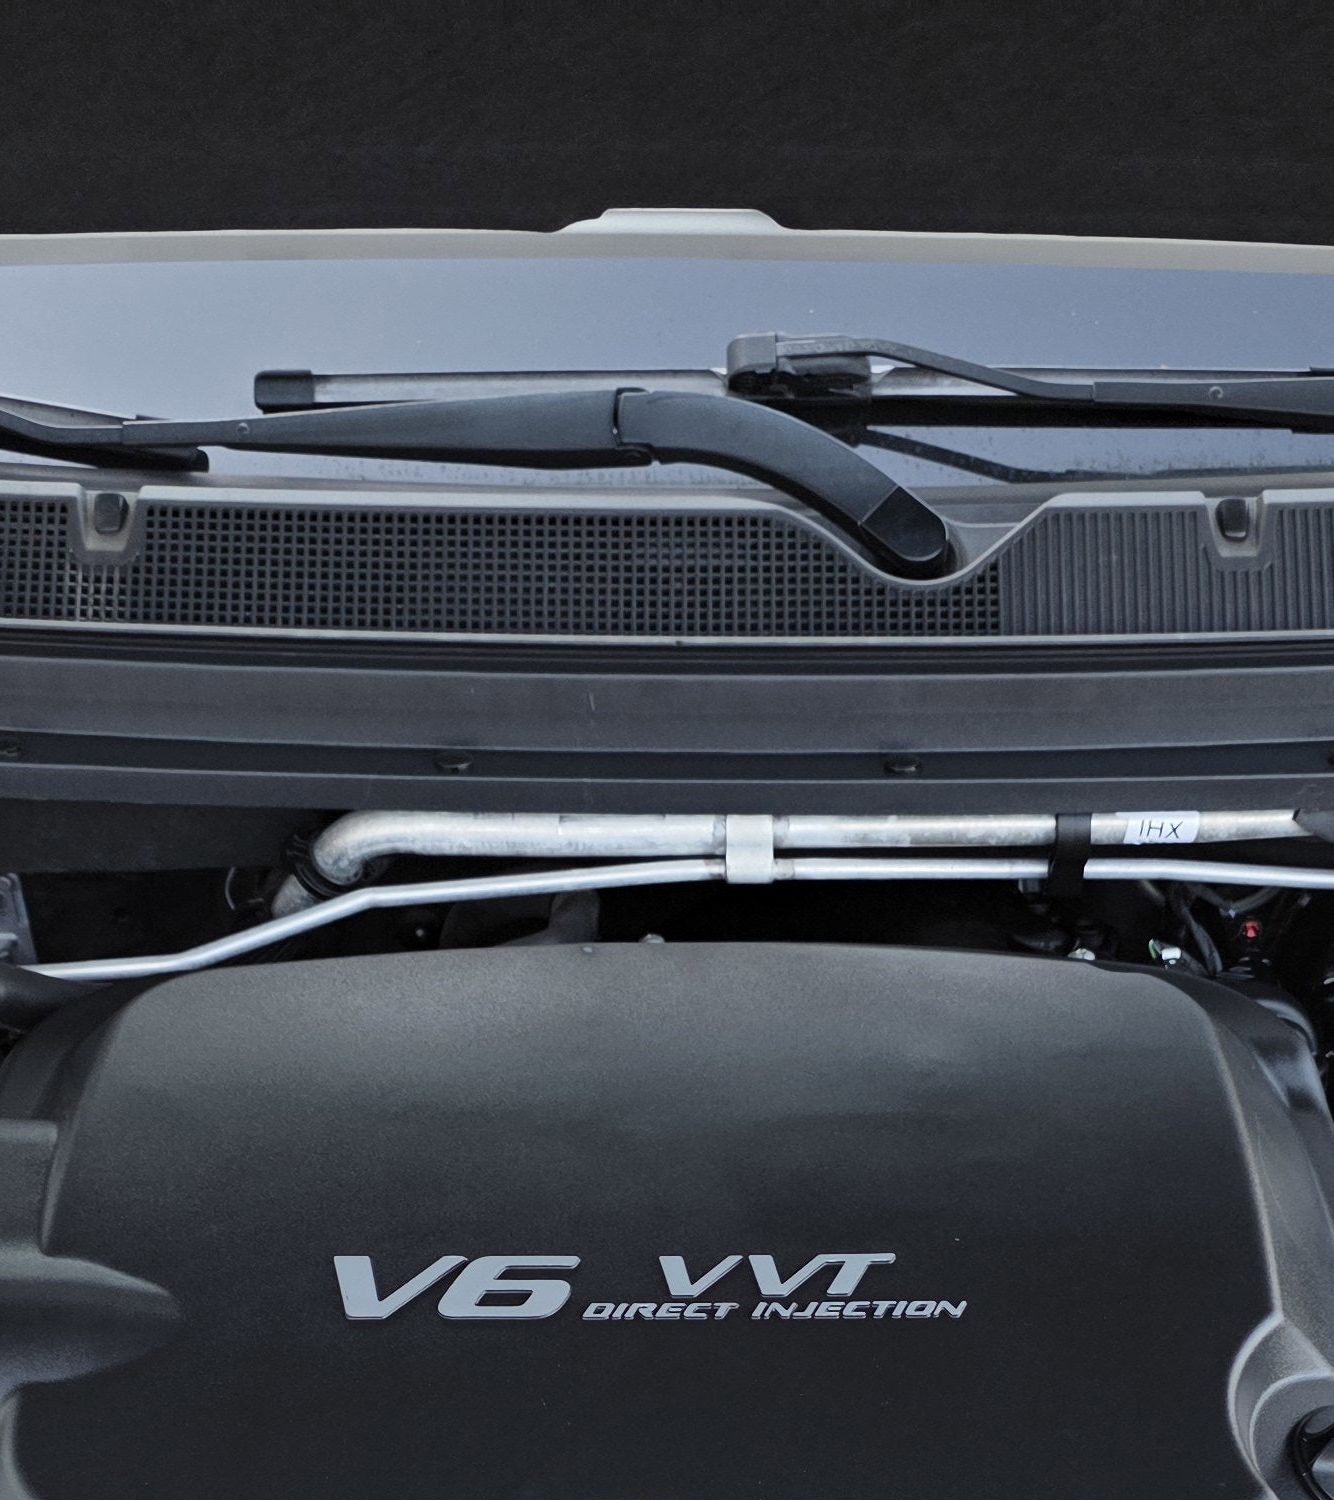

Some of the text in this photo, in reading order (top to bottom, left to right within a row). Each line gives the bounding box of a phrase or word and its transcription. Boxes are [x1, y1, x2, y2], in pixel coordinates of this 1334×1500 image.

[333, 1252, 897, 1320] V6 VVT
[581, 1300, 967, 1321] DIRECT INJECTION
